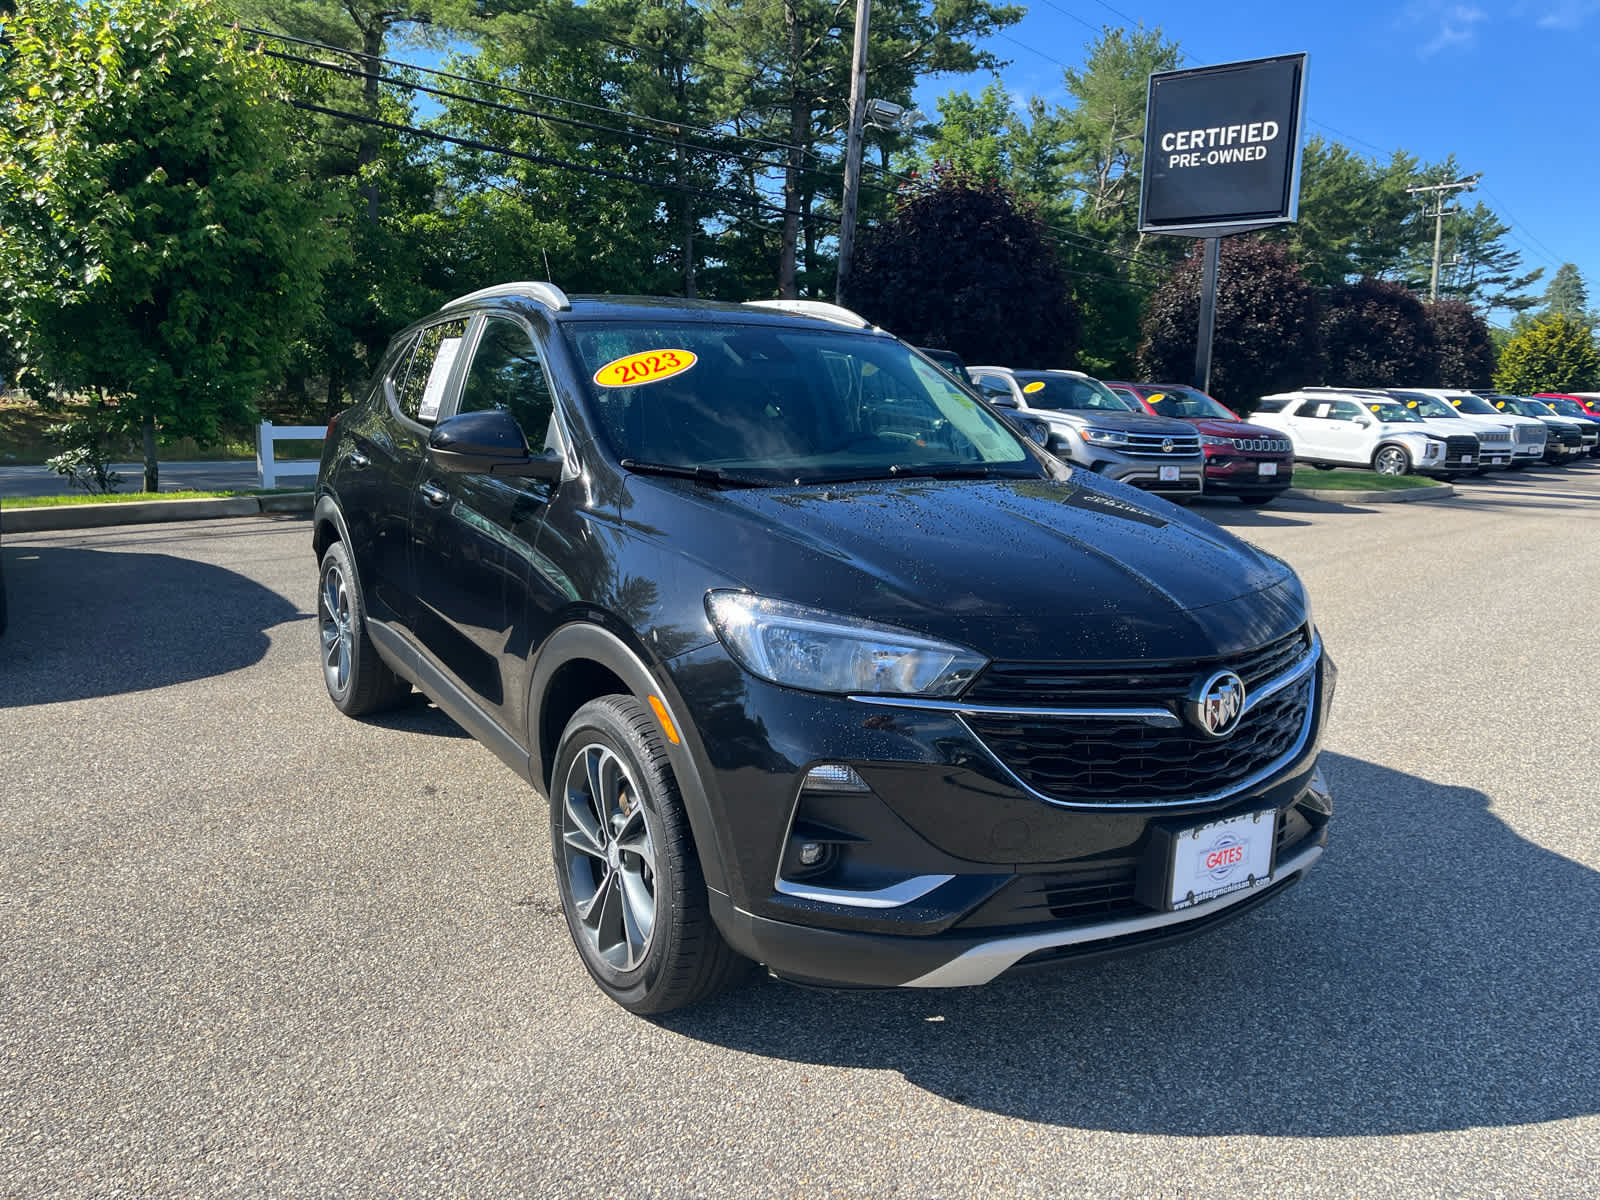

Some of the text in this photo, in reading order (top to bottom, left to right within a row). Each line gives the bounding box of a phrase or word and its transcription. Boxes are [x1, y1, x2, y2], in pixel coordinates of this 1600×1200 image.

[1161, 121, 1279, 152] CERTIFIED
[1169, 145, 1267, 169] PRE-OWNED
[614, 352, 681, 383] 2023
[1206, 846, 1243, 869] GATES
